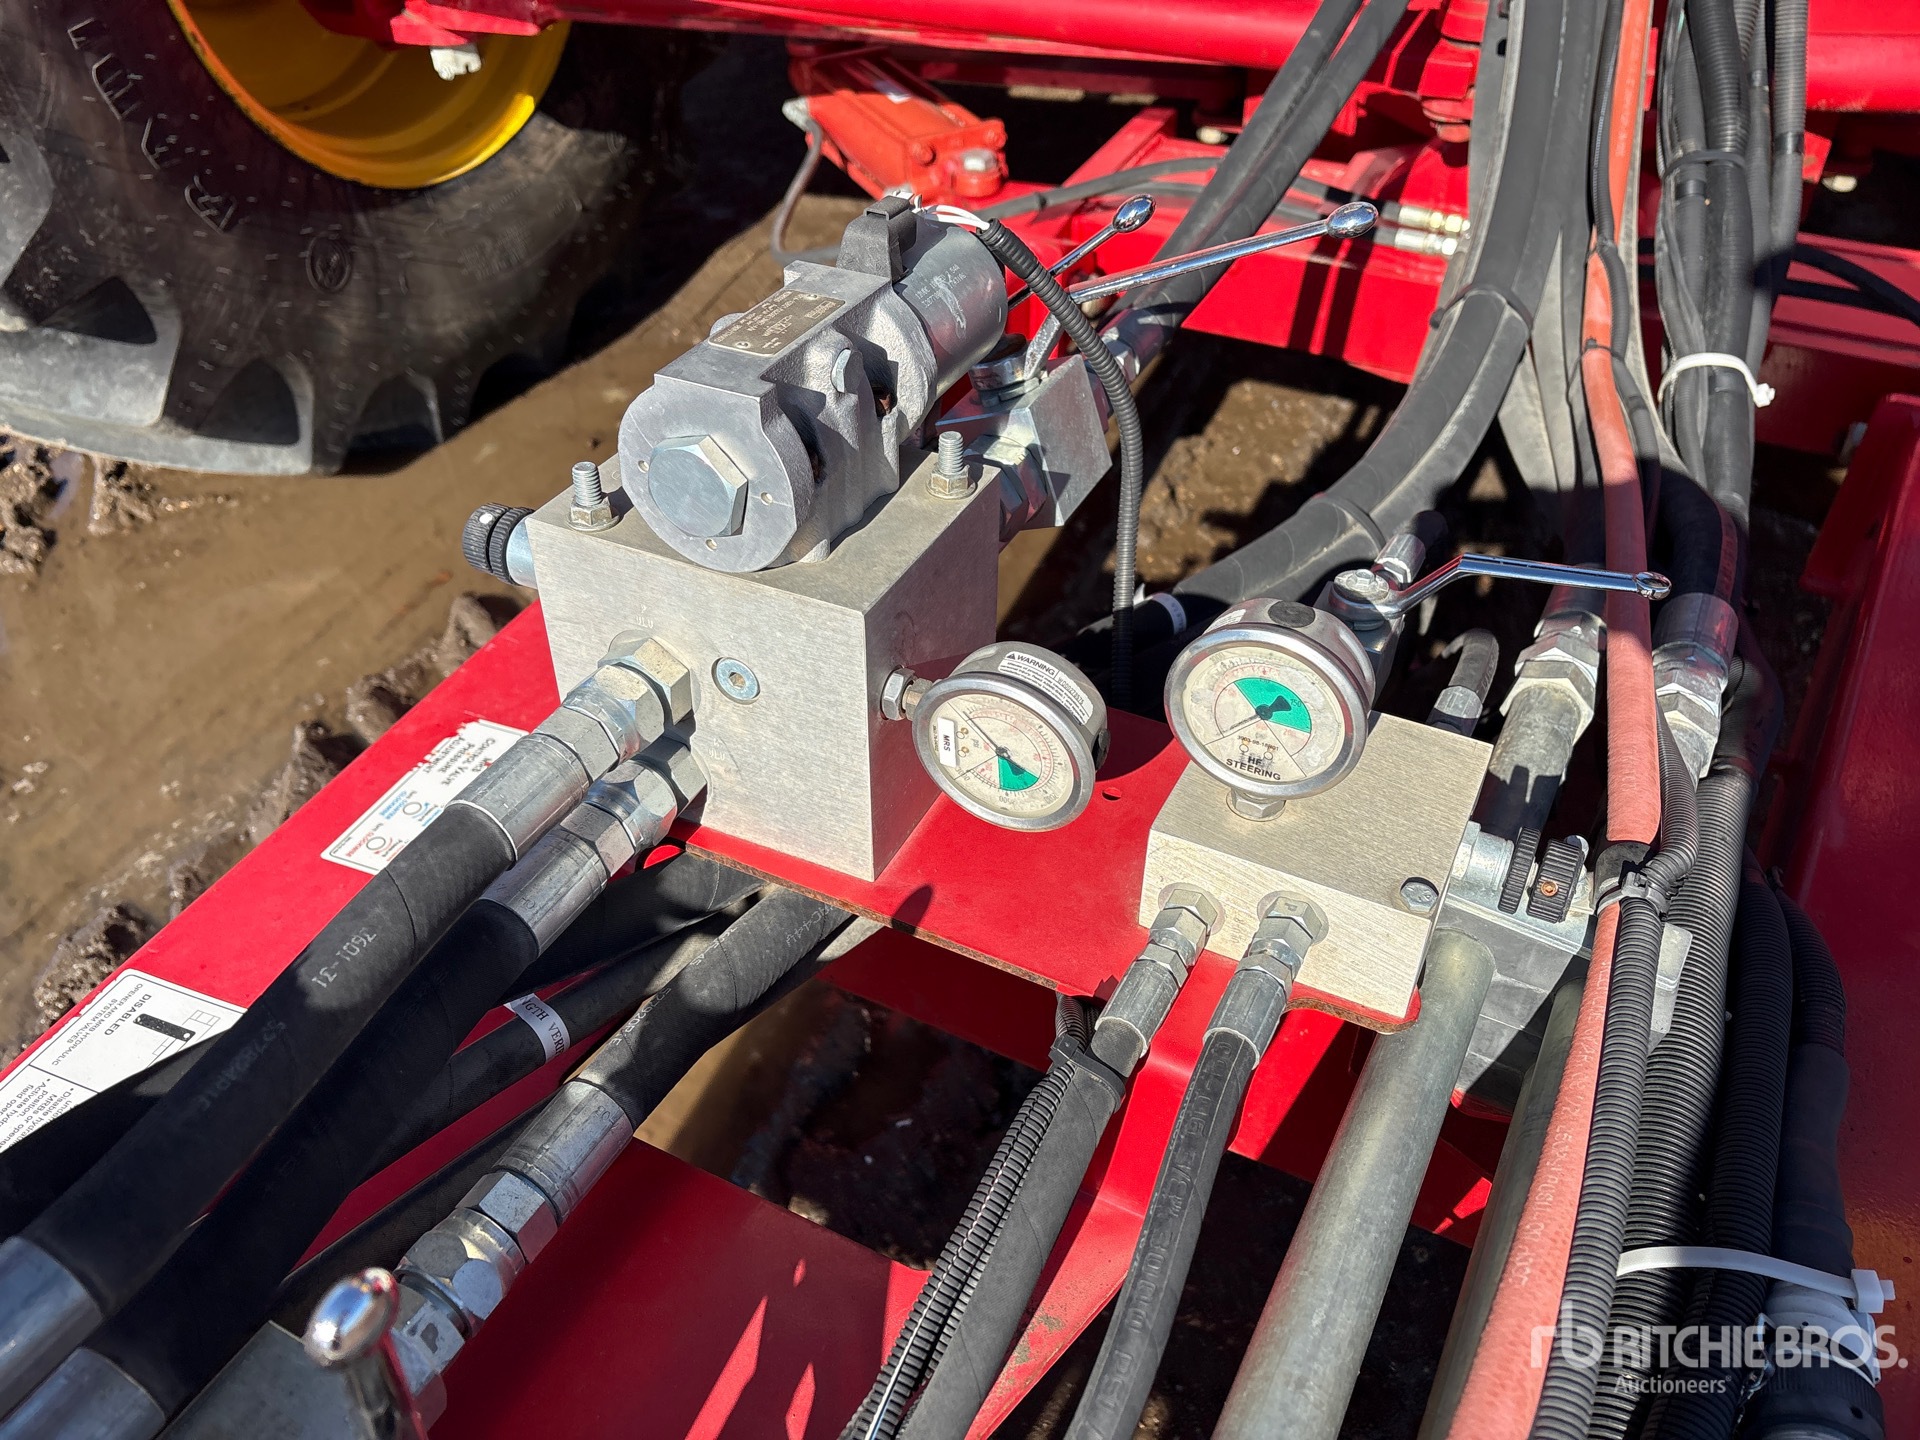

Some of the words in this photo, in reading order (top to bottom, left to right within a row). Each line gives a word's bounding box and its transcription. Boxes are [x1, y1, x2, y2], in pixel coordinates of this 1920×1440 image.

[1016, 654, 1056, 676] WARNING
[942, 734, 951, 752] MRS
[1225, 758, 1281, 781] STEERING
[1247, 755, 1263, 766] HF
[115, 982, 144, 1006] OPENER
[88, 997, 120, 1022] SYSTEM
[101, 1005, 120, 1019] AND
[101, 993, 153, 1036] DISABLED
[65, 1021, 94, 1044] VALVES
[86, 1017, 106, 1032] MRB
[50, 1031, 91, 1066] HYDRAULIC
[9, 1083, 35, 1103] field
[14, 1081, 48, 1109] Activate
[14, 1089, 51, 1119] position.
[30, 1093, 59, 1115] MRBs
[39, 1090, 72, 1116] Disable
[21, 1114, 34, 1124] or
